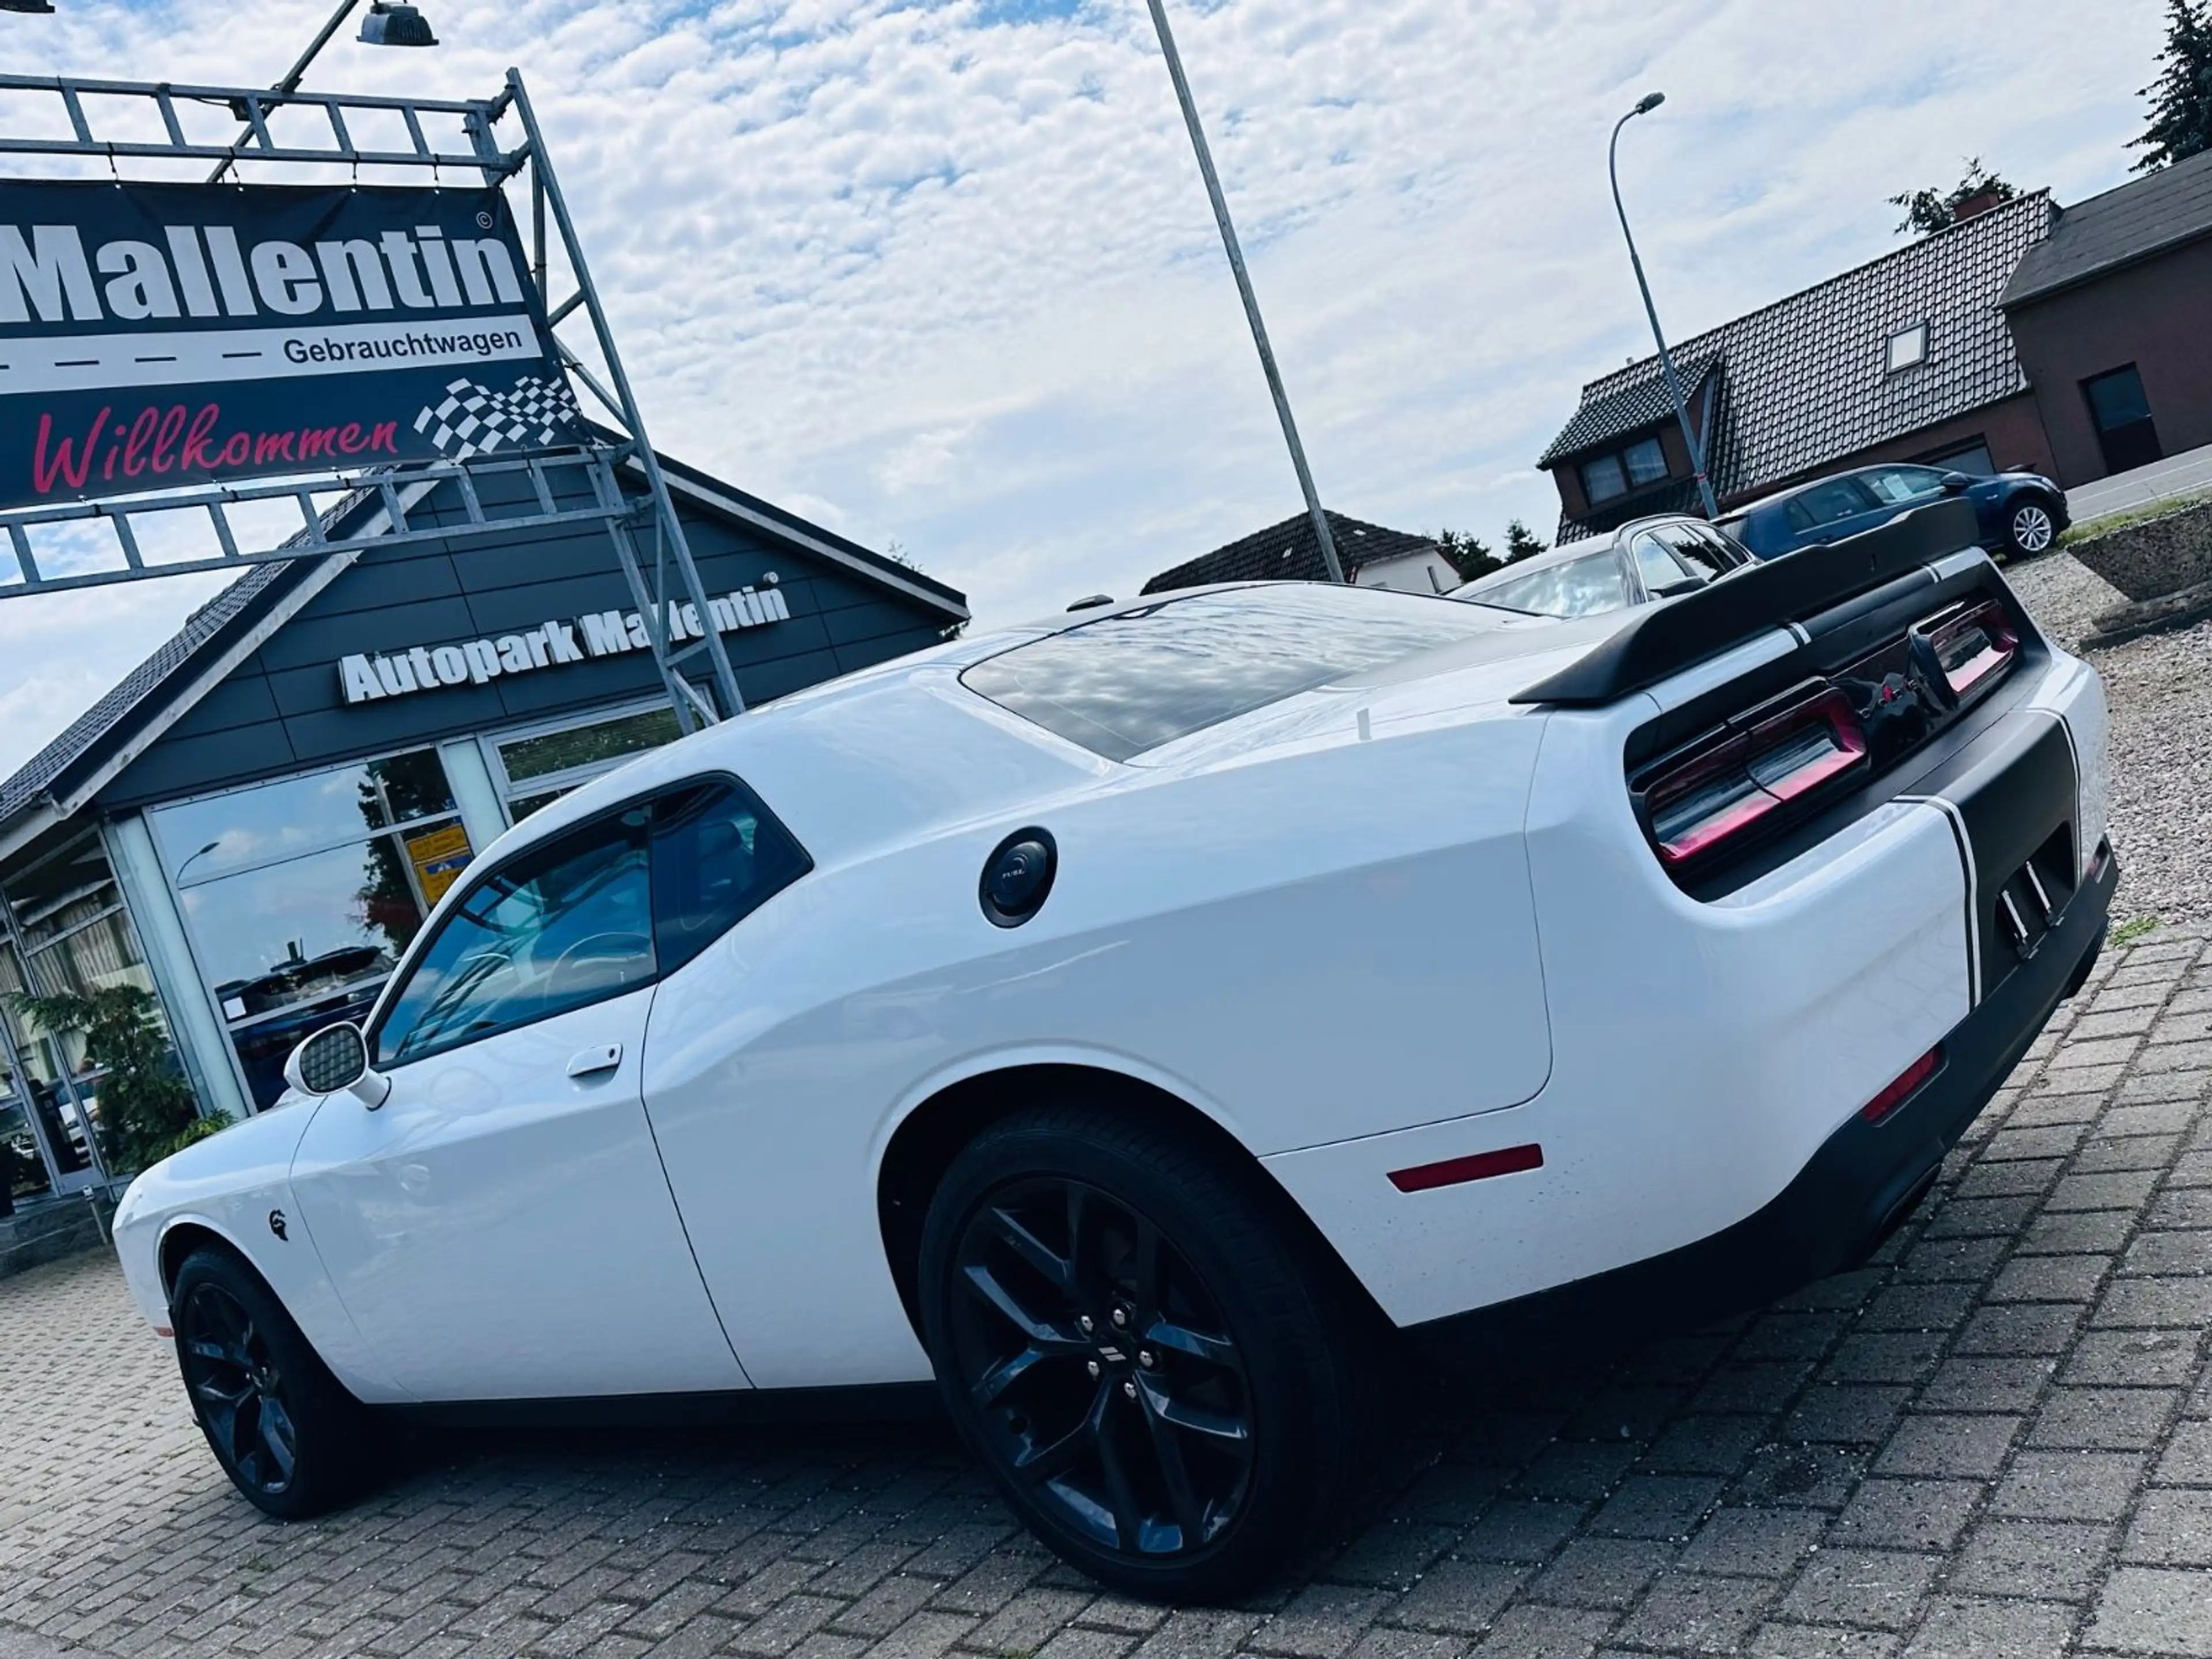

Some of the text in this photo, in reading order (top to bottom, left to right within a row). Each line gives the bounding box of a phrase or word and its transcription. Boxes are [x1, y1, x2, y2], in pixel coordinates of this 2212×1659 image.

[0, 224, 524, 323] Mallentin
[284, 328, 522, 364] Gebrauchtwagen
[33, 403, 400, 494] Willkommen
[340, 585, 790, 702] Autopark Malentin
